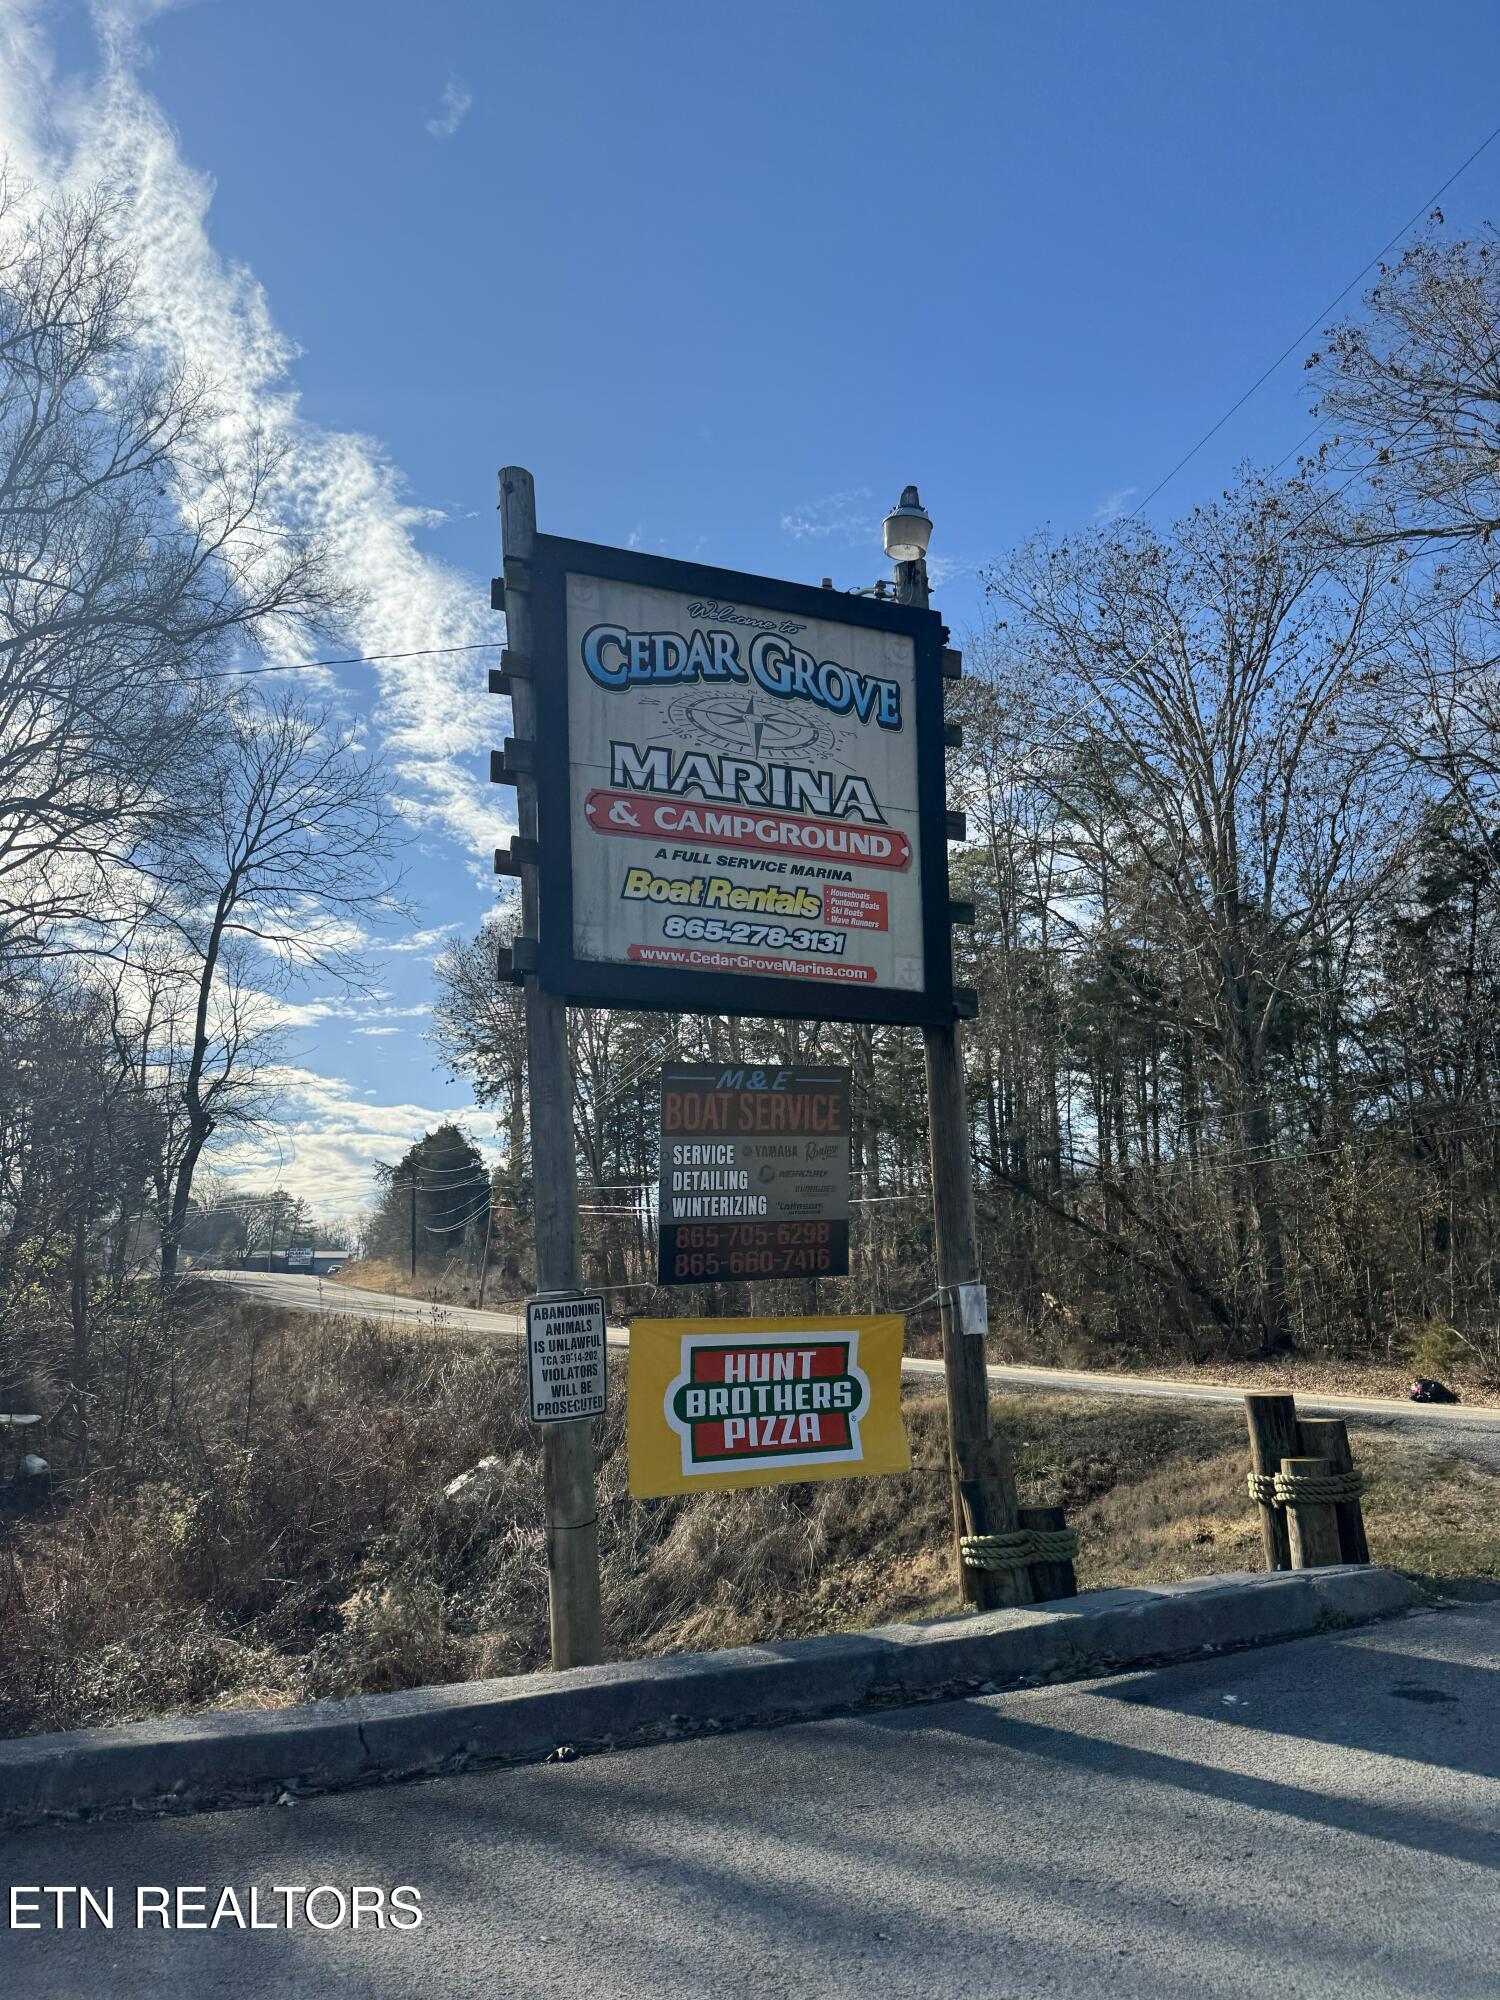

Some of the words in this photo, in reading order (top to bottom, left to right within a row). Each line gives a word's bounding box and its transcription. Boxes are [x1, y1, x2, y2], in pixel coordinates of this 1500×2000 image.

[687, 600, 776, 630] Welcome
[779, 620, 807, 635] to
[609, 740, 888, 826] MARINA
[608, 800, 641, 827] &
[654, 806, 892, 858] CAMPGROUND
[654, 848, 667, 860] A
[672, 850, 712, 865] FULL
[716, 855, 786, 874] SERVICE
[790, 864, 853, 882] MARINA
[621, 867, 708, 905] Boat
[702, 876, 822, 920] Rentals
[831, 888, 871, 901] Houseboats
[831, 897, 859, 907] Pontoon
[860, 900, 880, 910] Boats
[831, 906, 843, 914] Ski
[844, 907, 864, 917] Boats
[831, 915, 850, 924] Wave
[851, 917, 879, 928] Runners
[663, 915, 846, 955] 865-278-3131
[639, 948, 868, 980] www.CedarGroveMarina.com
[665, 1092, 734, 1131] BOAT
[738, 1093, 841, 1132] SERVICE
[672, 1144, 735, 1166] SERVICE
[672, 1170, 748, 1191] DETAILING
[672, 1195, 767, 1218] WINTERIZING
[675, 1222, 830, 1249] 865-705-6298
[674, 1248, 831, 1277] 865-660-7416
[533, 1302, 600, 1320] ABANDONING
[546, 1320, 592, 1336] ANIMALS
[534, 1341, 545, 1354] IS
[548, 1335, 602, 1353] UNLAWFUL
[541, 1356, 558, 1366] TCA
[724, 1351, 817, 1384] HUNT
[542, 1364, 598, 1382] VIOLATORS
[551, 1382, 578, 1398] WILL
[580, 1381, 593, 1394] BE
[686, 1381, 852, 1418] BROTHERS
[537, 1395, 603, 1416] PROSECUTED
[723, 1413, 821, 1449] PIZZA
